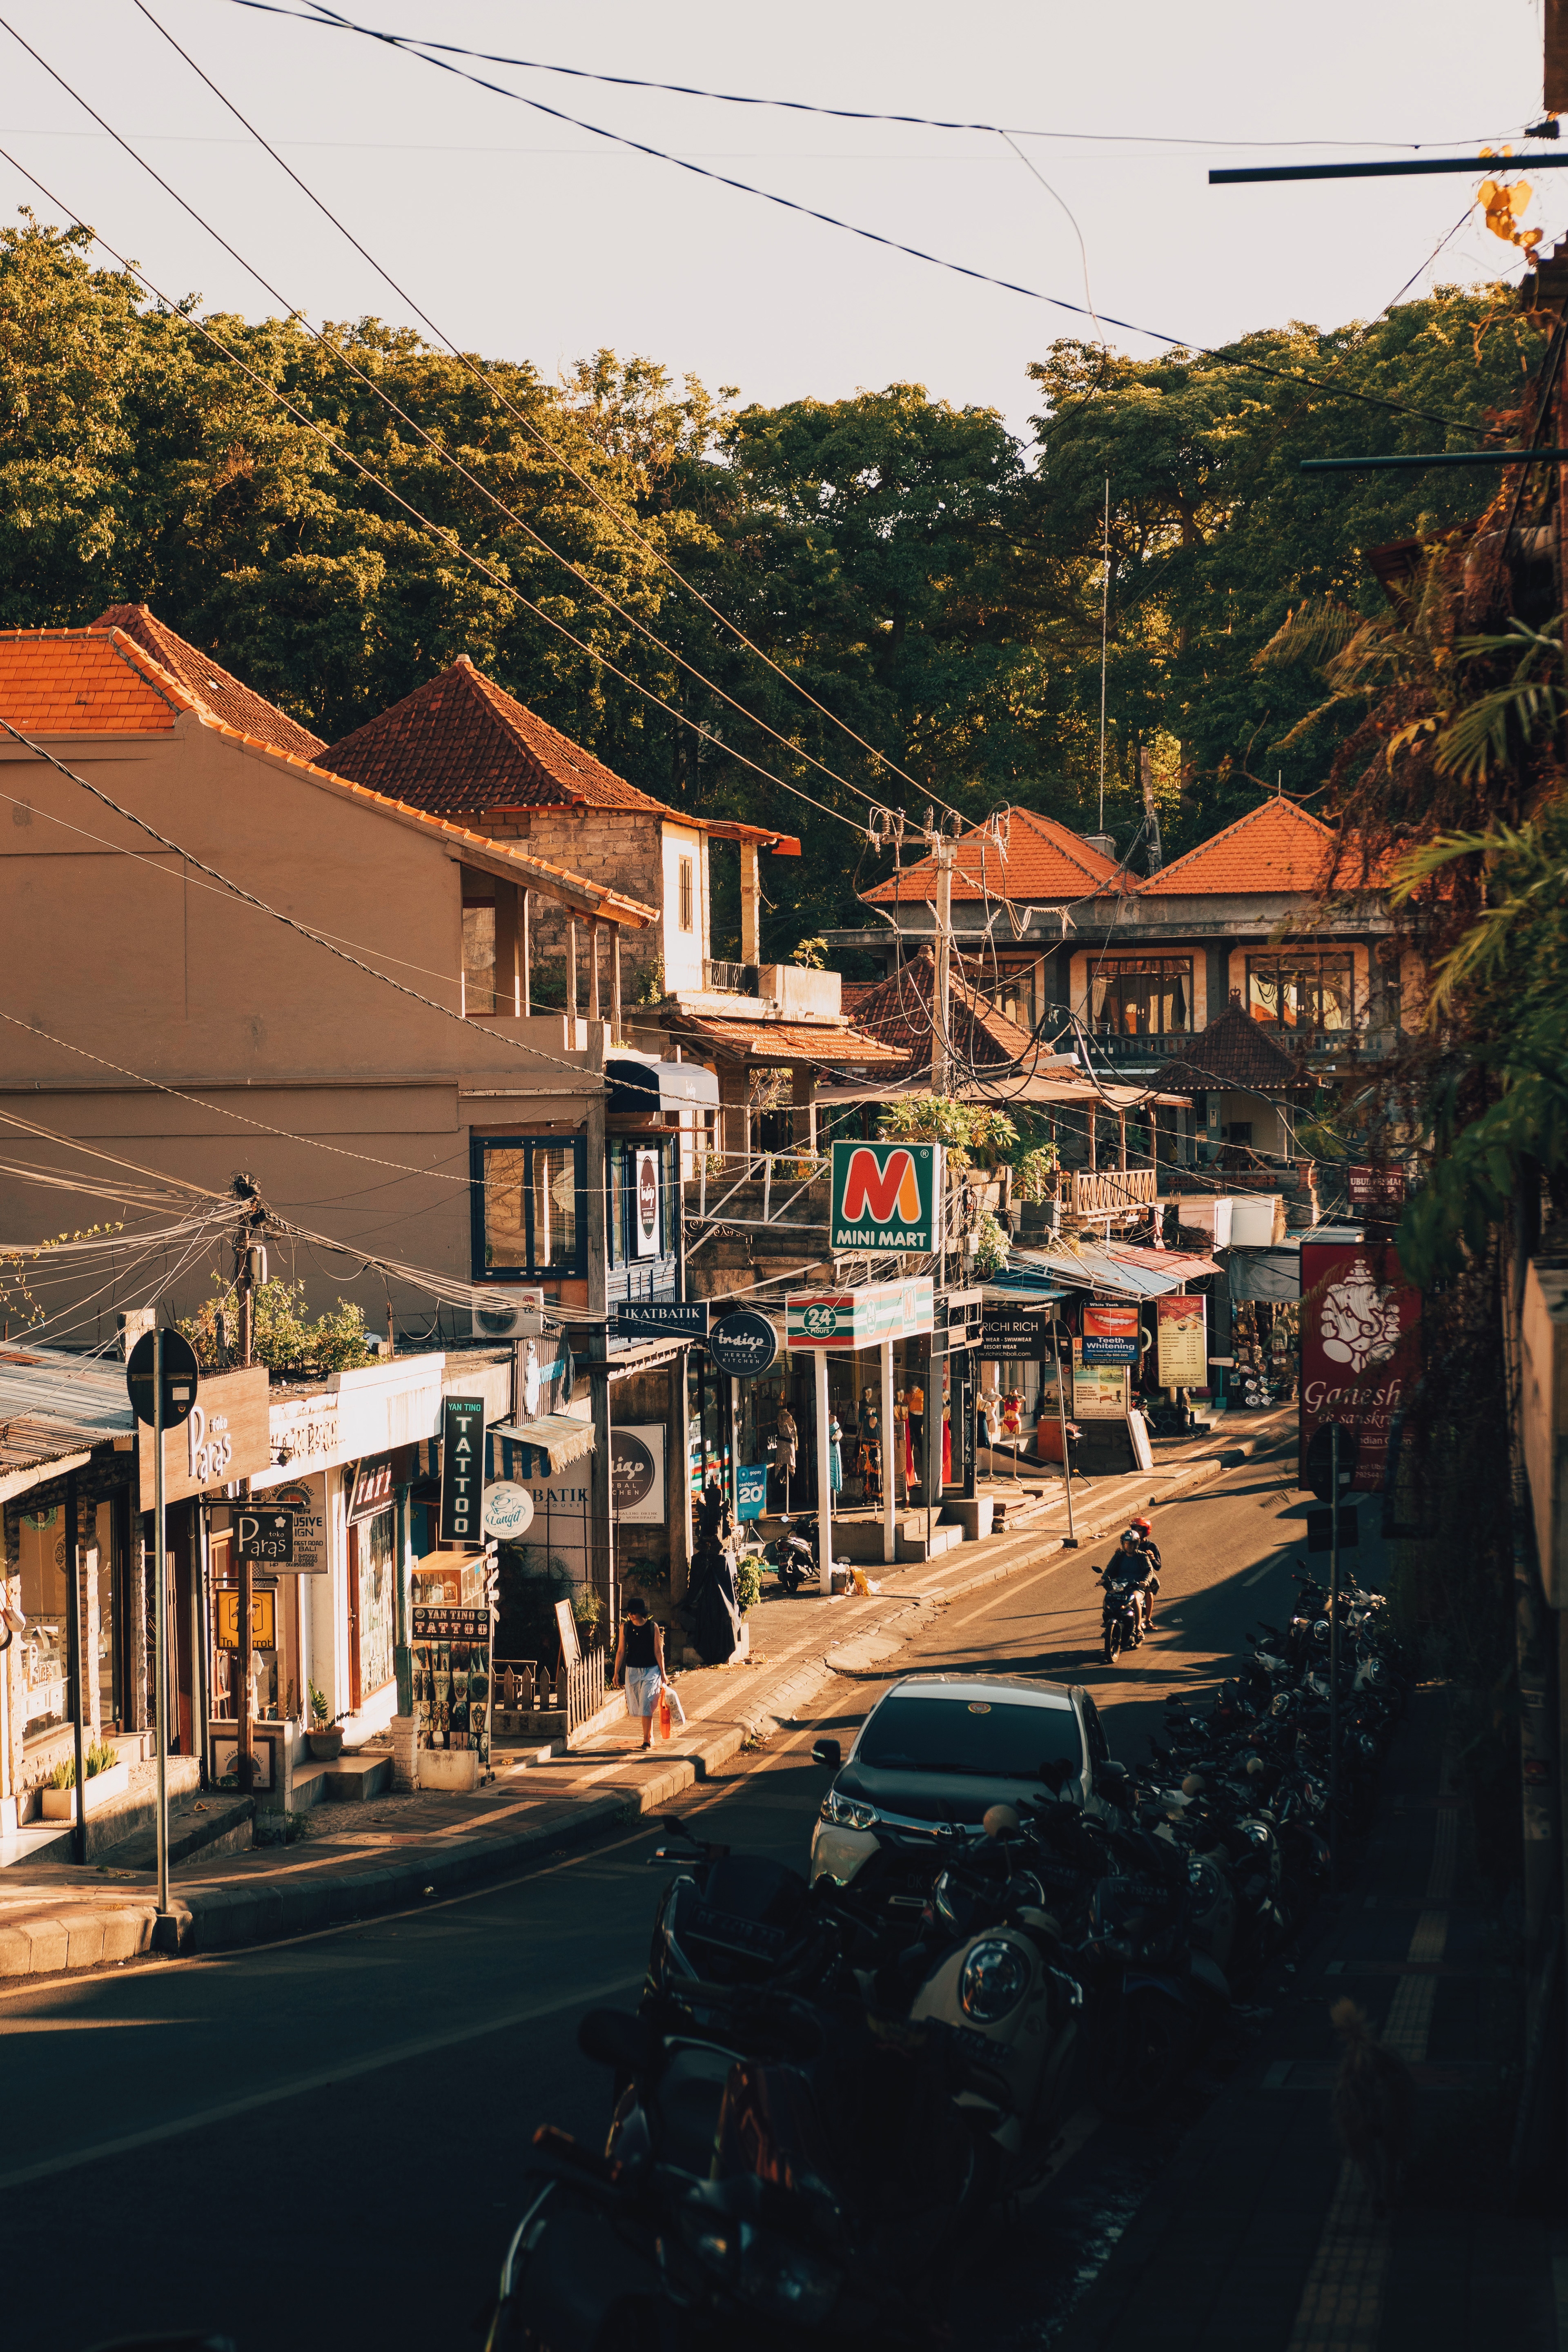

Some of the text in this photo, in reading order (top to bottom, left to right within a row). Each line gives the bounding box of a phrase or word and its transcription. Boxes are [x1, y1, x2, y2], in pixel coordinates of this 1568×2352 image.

[842, 1147, 922, 1224] M
[837, 1230, 927, 1247] MINI MART
[1183, 1299, 1201, 1308] Spa
[625, 1308, 700, 1319] IKATBATIK
[808, 1309, 831, 1326] 24
[982, 1322, 1038, 1331] RICHI RICH
[718, 1328, 764, 1351] indigo
[1305, 1379, 1401, 1414] Ganesh
[464, 1403, 481, 1412] TINO
[209, 1415, 228, 1432] toko
[767, 1434, 777, 1450] SALE
[356, 1462, 391, 1505] TATT
[454, 1417, 473, 1534] TATTOO
[300, 1481, 315, 1497] PAGI
[526, 1488, 589, 1501] BATIK
[294, 1517, 322, 1526] USIVE
[490, 1510, 521, 1527] Langit
[238, 1517, 286, 1557] Paras
[294, 1528, 314, 1537] IGN
[427, 1610, 475, 1620] YAN TINO
[415, 1621, 488, 1635] TATTOO
[220, 1637, 273, 1648] Tn. rrot
[223, 1748, 238, 1762] MENT
[907, 1873, 922, 1889] DK
[1115, 1884, 1126, 1893] DK
